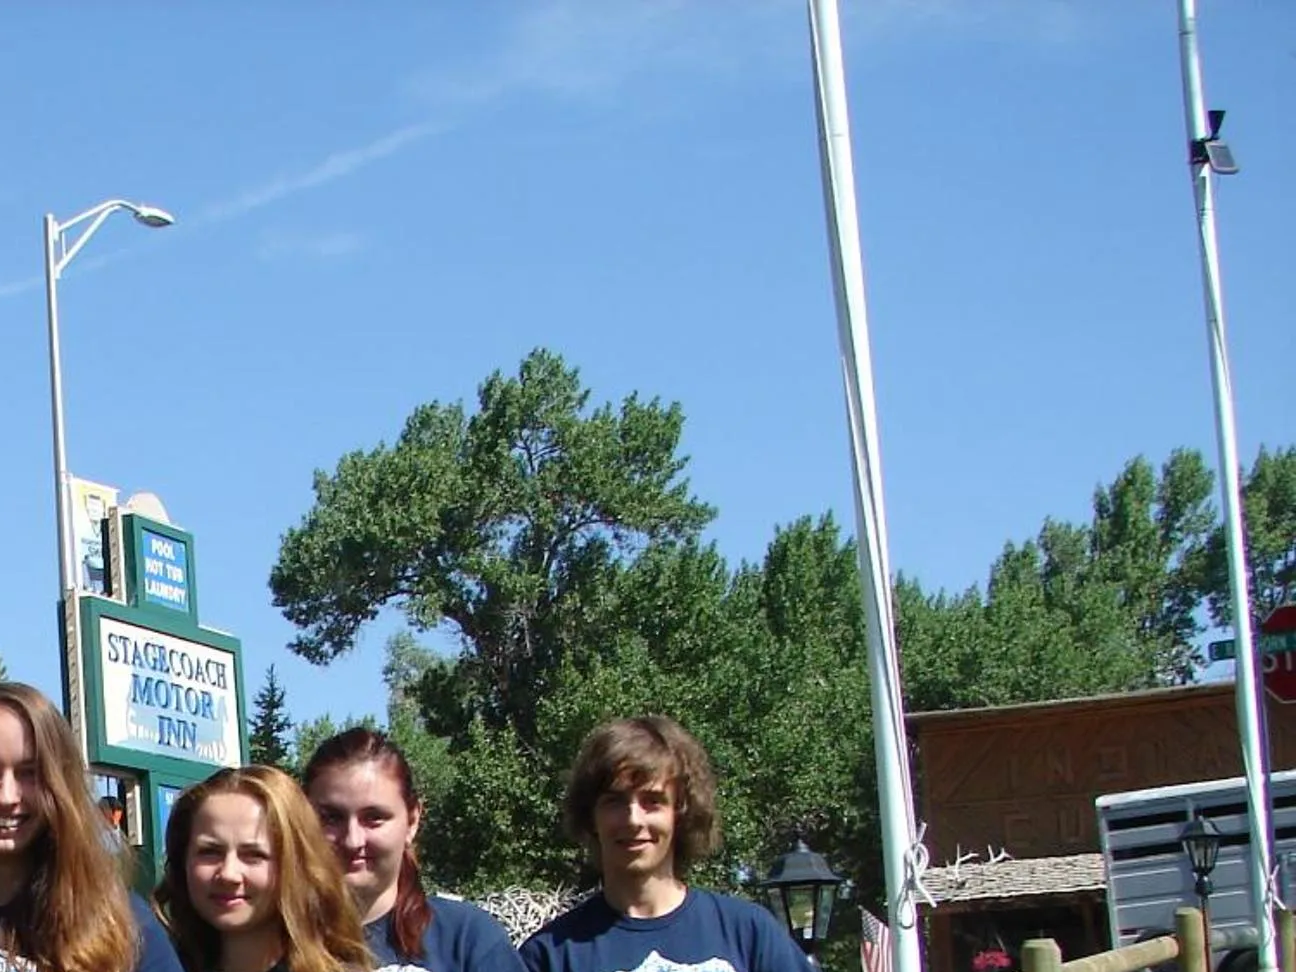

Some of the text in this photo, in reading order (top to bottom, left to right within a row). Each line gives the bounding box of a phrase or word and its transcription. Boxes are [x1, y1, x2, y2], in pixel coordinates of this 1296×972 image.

[152, 539, 175, 560] POOL
[145, 557, 163, 576] HOT
[145, 578, 186, 604] LAUNDRY
[108, 632, 227, 690] STAGECOACH
[131, 673, 216, 720] MOTOR
[158, 715, 197, 753] INN
